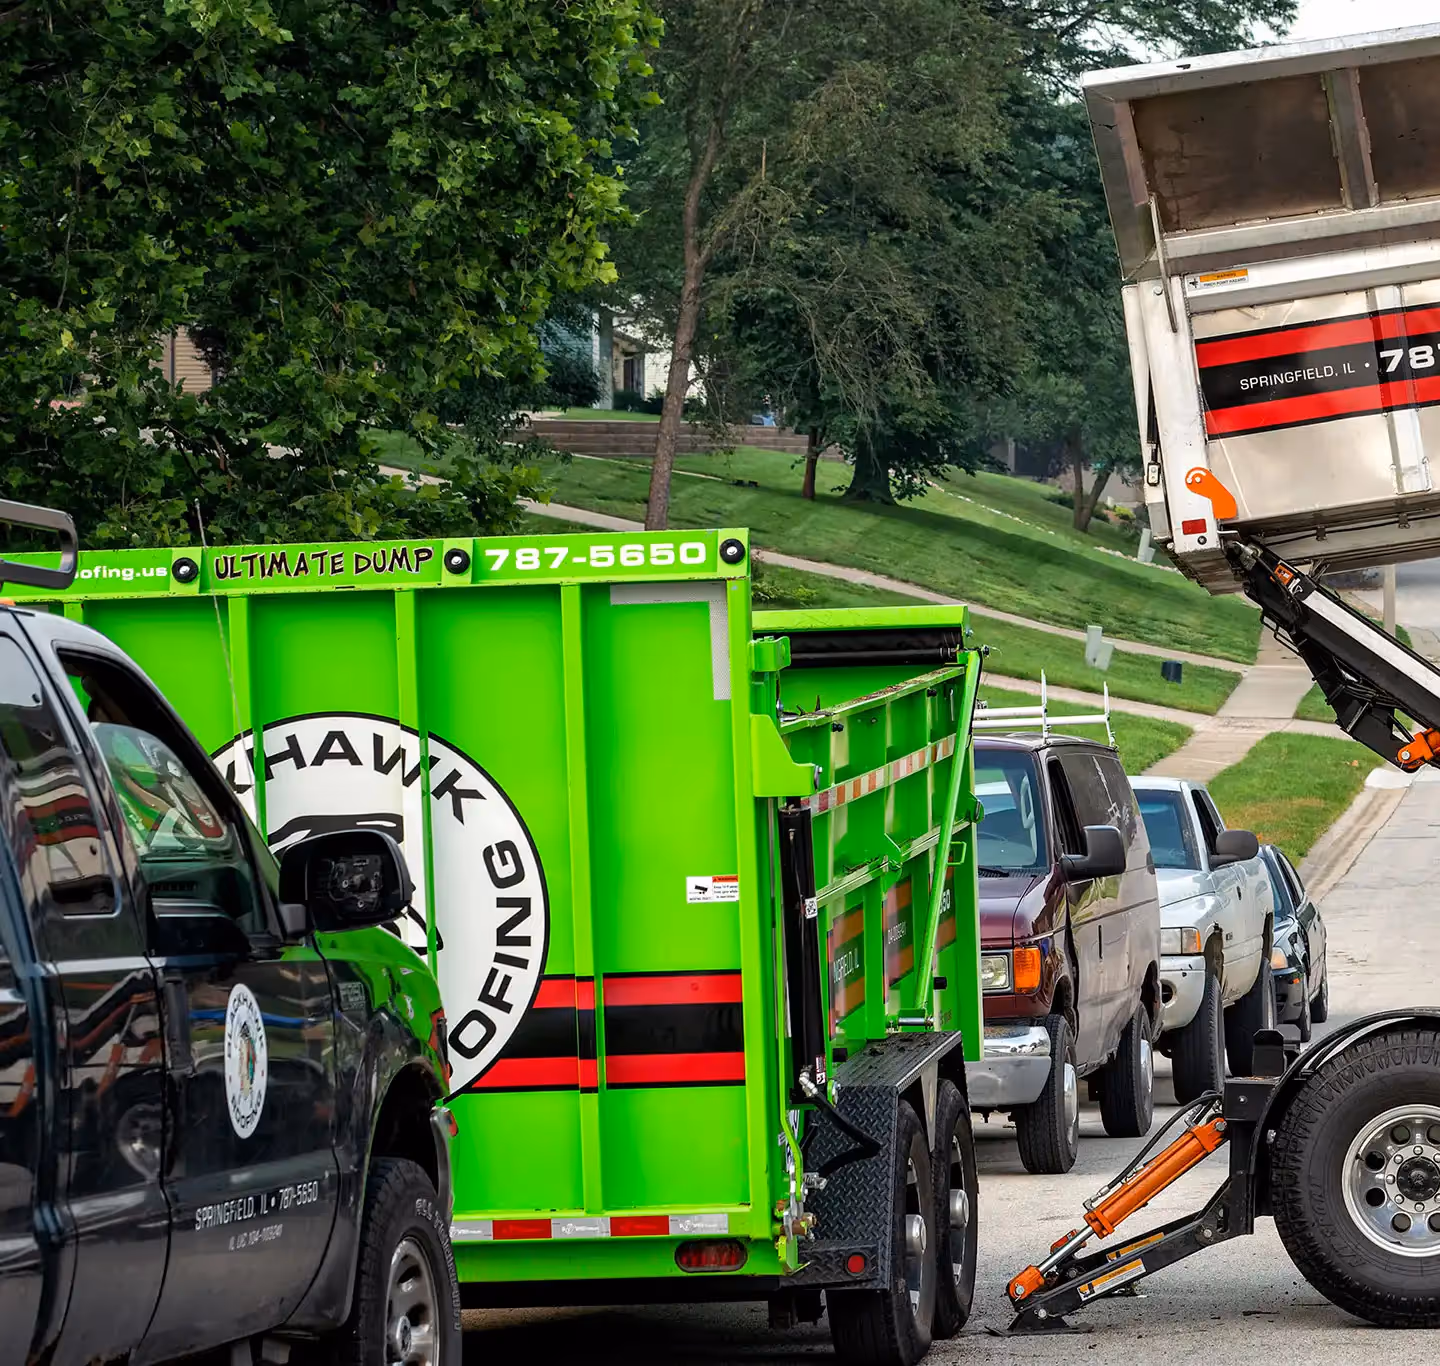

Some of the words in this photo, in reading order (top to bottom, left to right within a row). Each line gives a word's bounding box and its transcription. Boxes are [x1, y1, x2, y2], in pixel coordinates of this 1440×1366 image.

[1239, 365, 1340, 392] SPRINGFIELD,
[1342, 361, 1356, 375] IL
[214, 550, 345, 580] ULTIMATE
[353, 546, 434, 577] DUMP
[485, 542, 706, 572] 787-5650
[447, 839, 533, 1060] OFING
[230, 1088, 263, 1129] ROOFING
[195, 1196, 257, 1231] SPRINGFIELD,
[260, 1193, 269, 1216] IL
[278, 1180, 319, 1211] 787-5650
